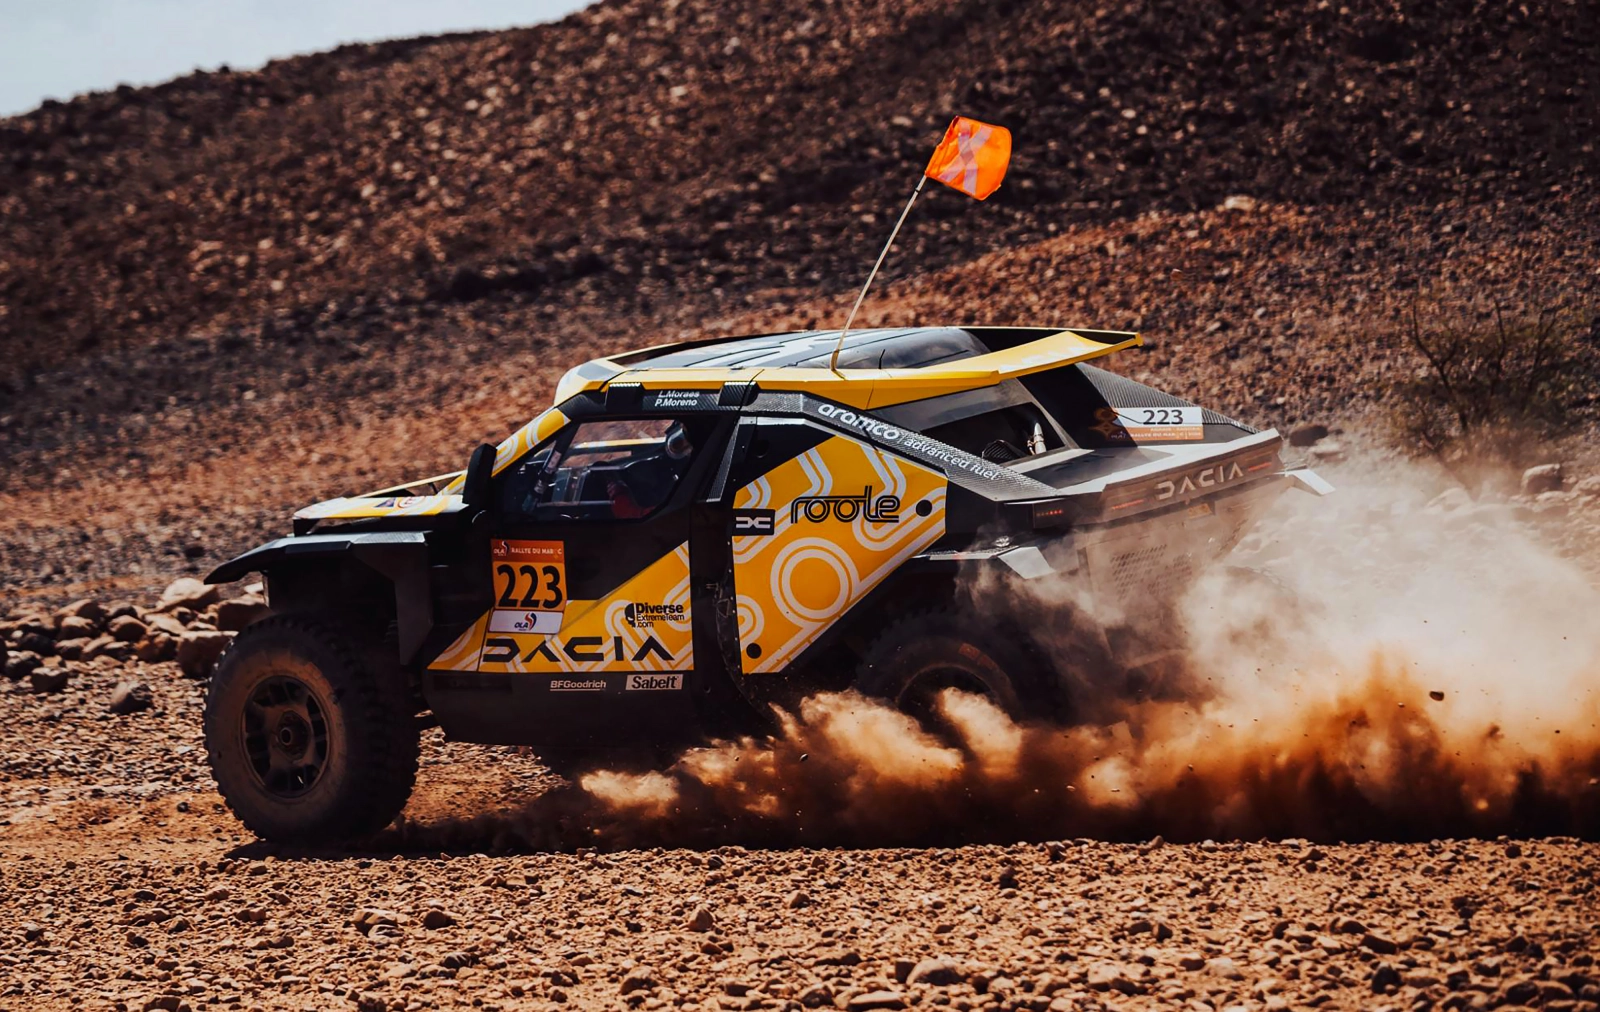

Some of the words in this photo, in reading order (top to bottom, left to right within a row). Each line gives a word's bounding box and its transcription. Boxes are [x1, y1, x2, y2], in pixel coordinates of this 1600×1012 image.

[654, 398, 697, 407] P.Moreno
[1143, 409, 1183, 425] 223
[817, 403, 900, 440] aramco
[904, 435, 972, 469] advanced
[970, 463, 1000, 481] fuel
[1155, 462, 1243, 500] DACIA
[497, 564, 562, 608] 223
[636, 602, 684, 613] Diverse
[636, 614, 685, 622] ExtremeTeam
[483, 635, 675, 662] DACIA
[550, 679, 606, 689] BFGoodrich
[632, 675, 678, 689] Sabelt
